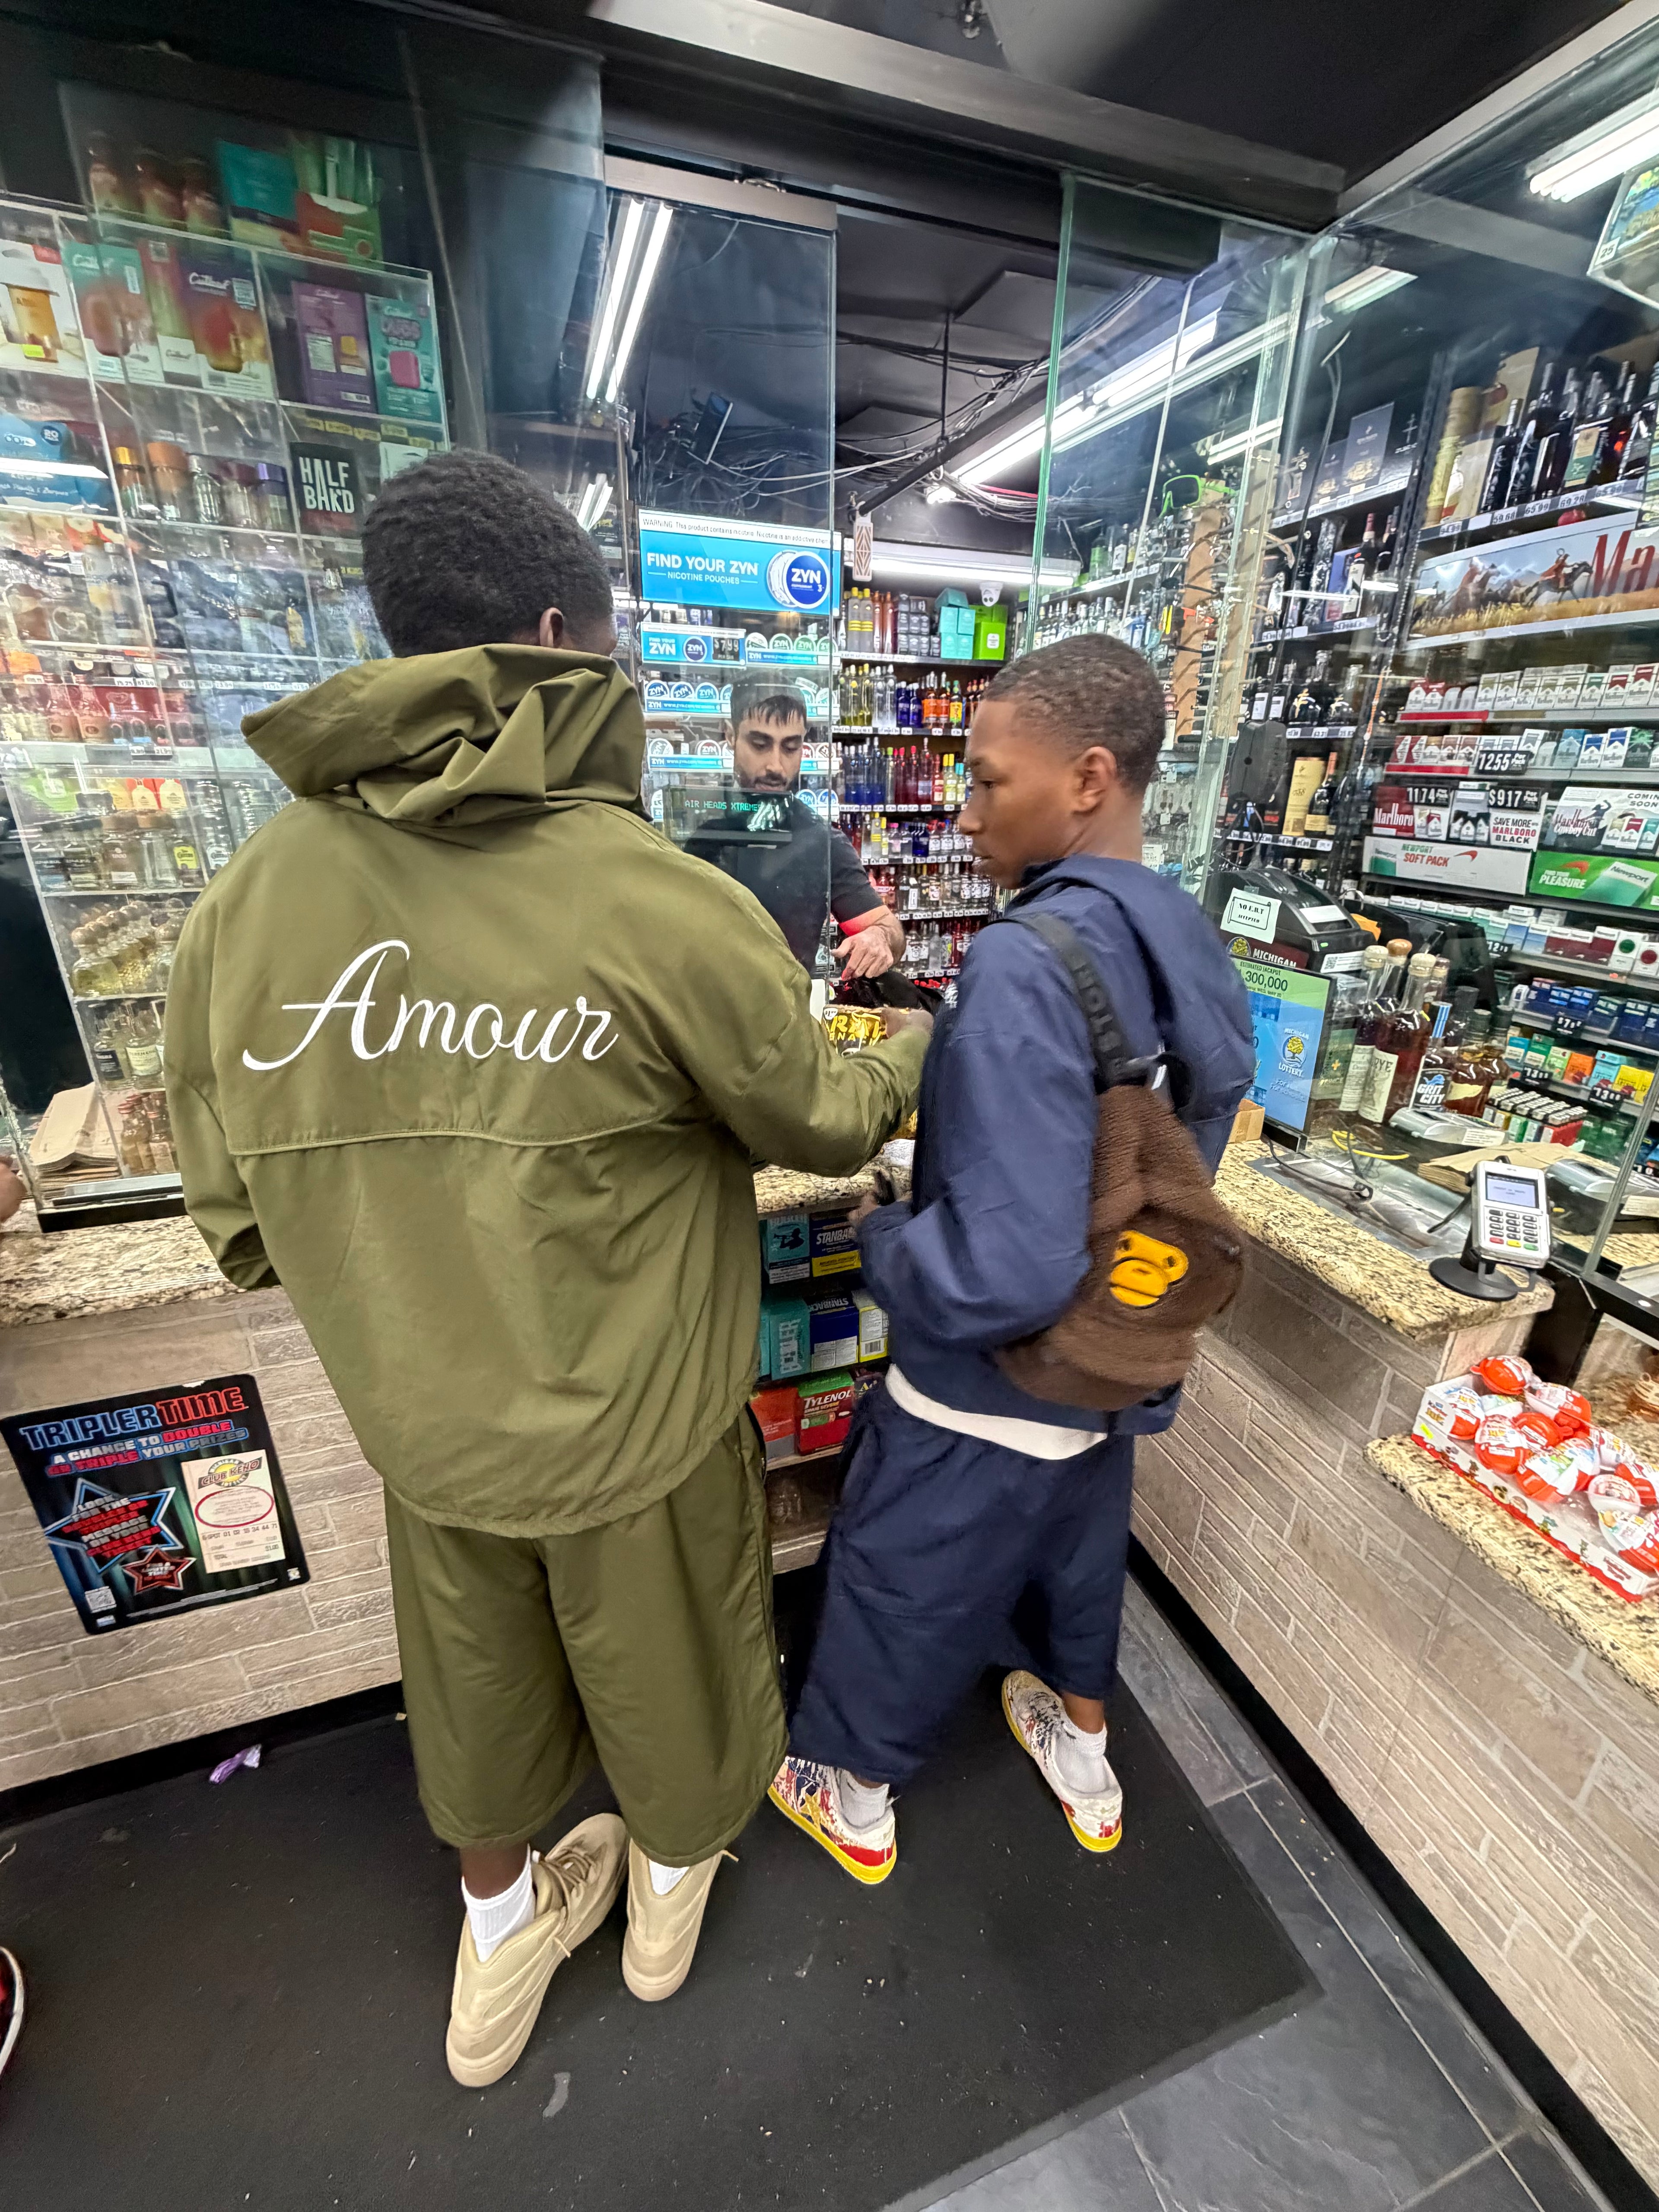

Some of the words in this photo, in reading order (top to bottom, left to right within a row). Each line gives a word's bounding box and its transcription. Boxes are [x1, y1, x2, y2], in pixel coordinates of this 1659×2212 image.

[1600, 245, 1614, 259] 25
[299, 456, 349, 488] HALF
[688, 524, 709, 532] product
[647, 552, 682, 569] FIND
[685, 556, 725, 573] YOUR
[729, 560, 758, 576] ZYN
[667, 571, 703, 582] NICOTINE
[705, 574, 740, 585] POUCHES
[791, 568, 821, 584] ZYN
[649, 642, 676, 656] ZYN
[687, 644, 703, 652] ZYN
[798, 641, 812, 649] ZYN
[648, 685, 665, 696] ZYN
[674, 686, 689, 698] ZYN
[685, 800, 699, 808] AIR
[703, 801, 727, 810] HEADS
[1374, 803, 1414, 826] Marlboro
[1493, 817, 1511, 826] SAVE
[1512, 819, 1532, 828] MORE
[1554, 823, 1583, 837] Cowboy
[1583, 825, 1597, 836] Cut
[1492, 826, 1536, 837] MARLBORO
[1495, 835, 1530, 844] BLACK
[1402, 843, 1434, 854] NEWPORT
[1403, 852, 1425, 864] SOFT
[1426, 855, 1450, 867] PACK
[1539, 874, 1587, 889] PLEASURE
[1610, 865, 1650, 883] Newport
[1253, 948, 1297, 968] MICHIGAN
[1240, 961, 1263, 972] ESTIMATED
[1263, 966, 1281, 976] JACKPOT
[1244, 970, 1288, 992] 300,000
[242, 937, 619, 1071] Amour
[1284, 1028, 1310, 1040] MICHIGAN
[1278, 1062, 1303, 1077] LOTTERY
[1417, 1084, 1444, 1095] GRIT
[1420, 1093, 1445, 1105] CITY
[804, 1390, 852, 1409] TYLENOL
[19, 1404, 162, 1451] TRIPLER
[155, 1386, 249, 1425] TIME
[54, 1453, 67, 1465] A
[67, 1440, 137, 1462] CHANCE
[137, 1434, 161, 1450] TO
[162, 1421, 232, 1443] DOUBLE
[74, 1450, 139, 1471] TRIPLE
[141, 1442, 186, 1459] YOUR
[189, 1429, 247, 1448] PRIZES
[201, 1471, 228, 1486] CLUB
[229, 1459, 260, 1477] KENO
[101, 1497, 131, 1512] THE
[81, 1515, 148, 1543] MESSAGE
[110, 1522, 150, 1540] YOUR
